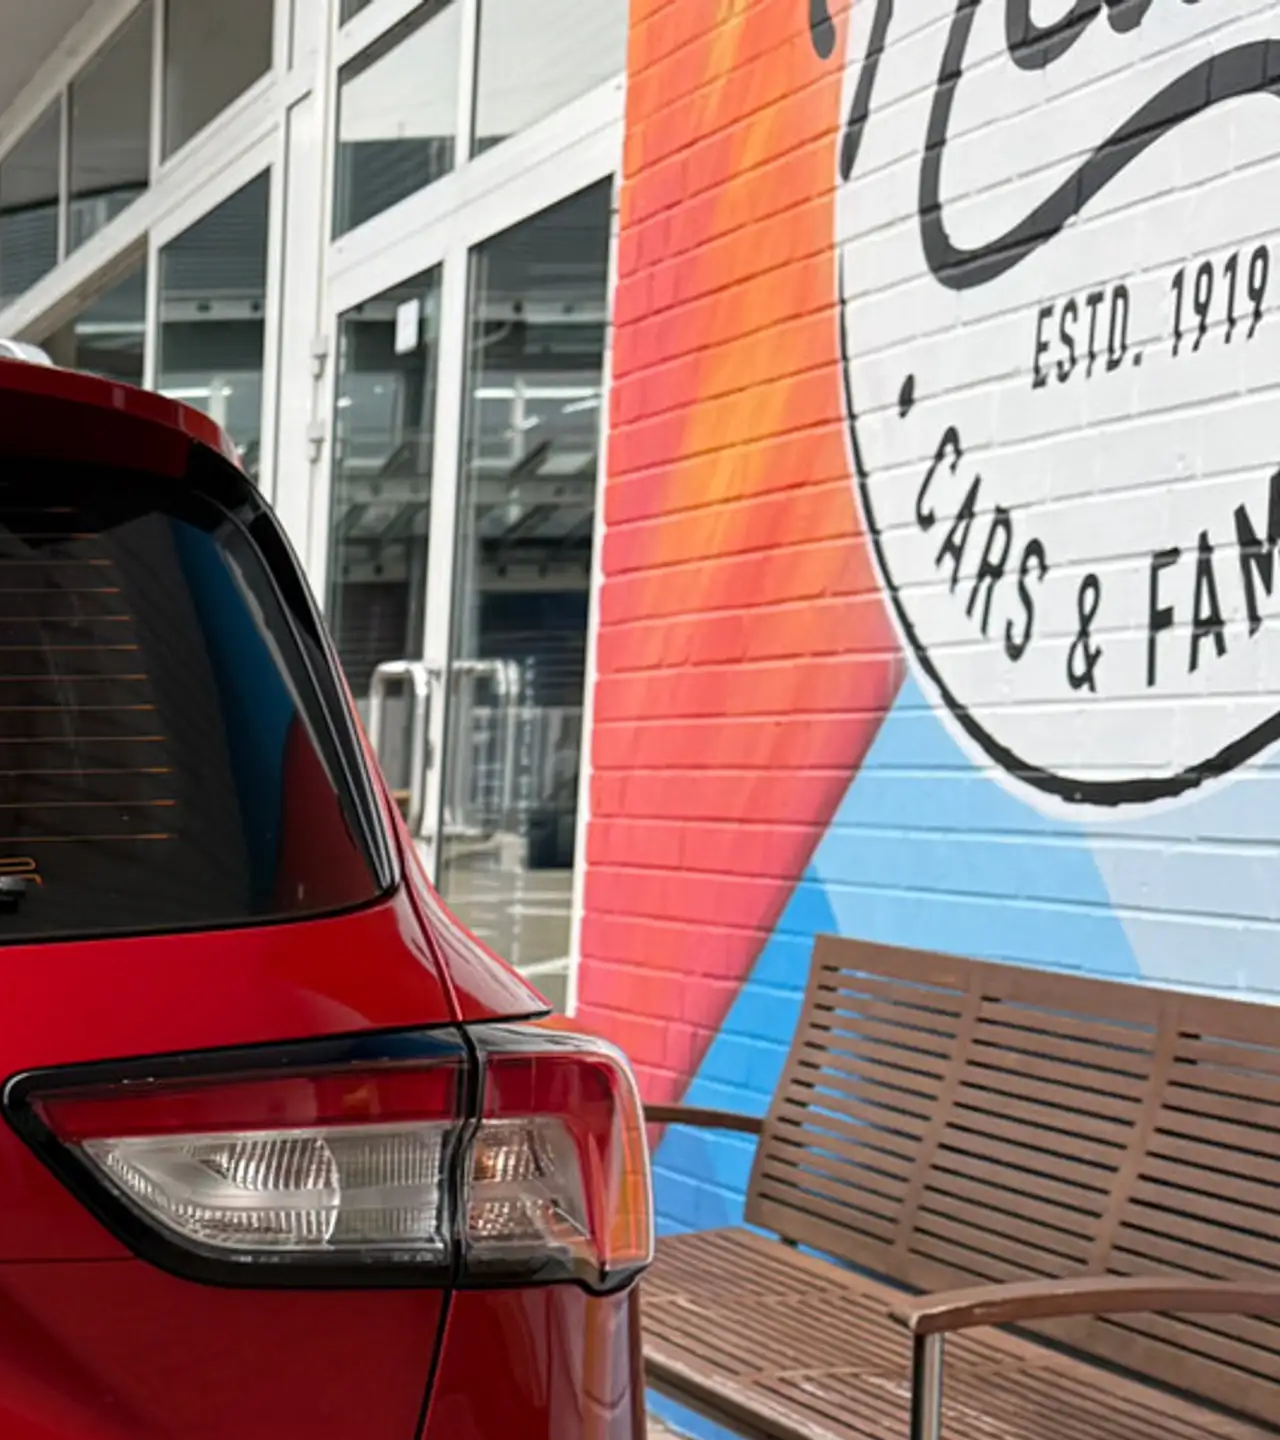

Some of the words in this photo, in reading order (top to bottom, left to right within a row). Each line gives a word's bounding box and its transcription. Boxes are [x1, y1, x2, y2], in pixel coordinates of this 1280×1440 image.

[1032, 284, 1142, 390] ESTD.
[1171, 244, 1270, 358] 1919
[916, 425, 1049, 663] CARS
[1067, 573, 1102, 693] &
